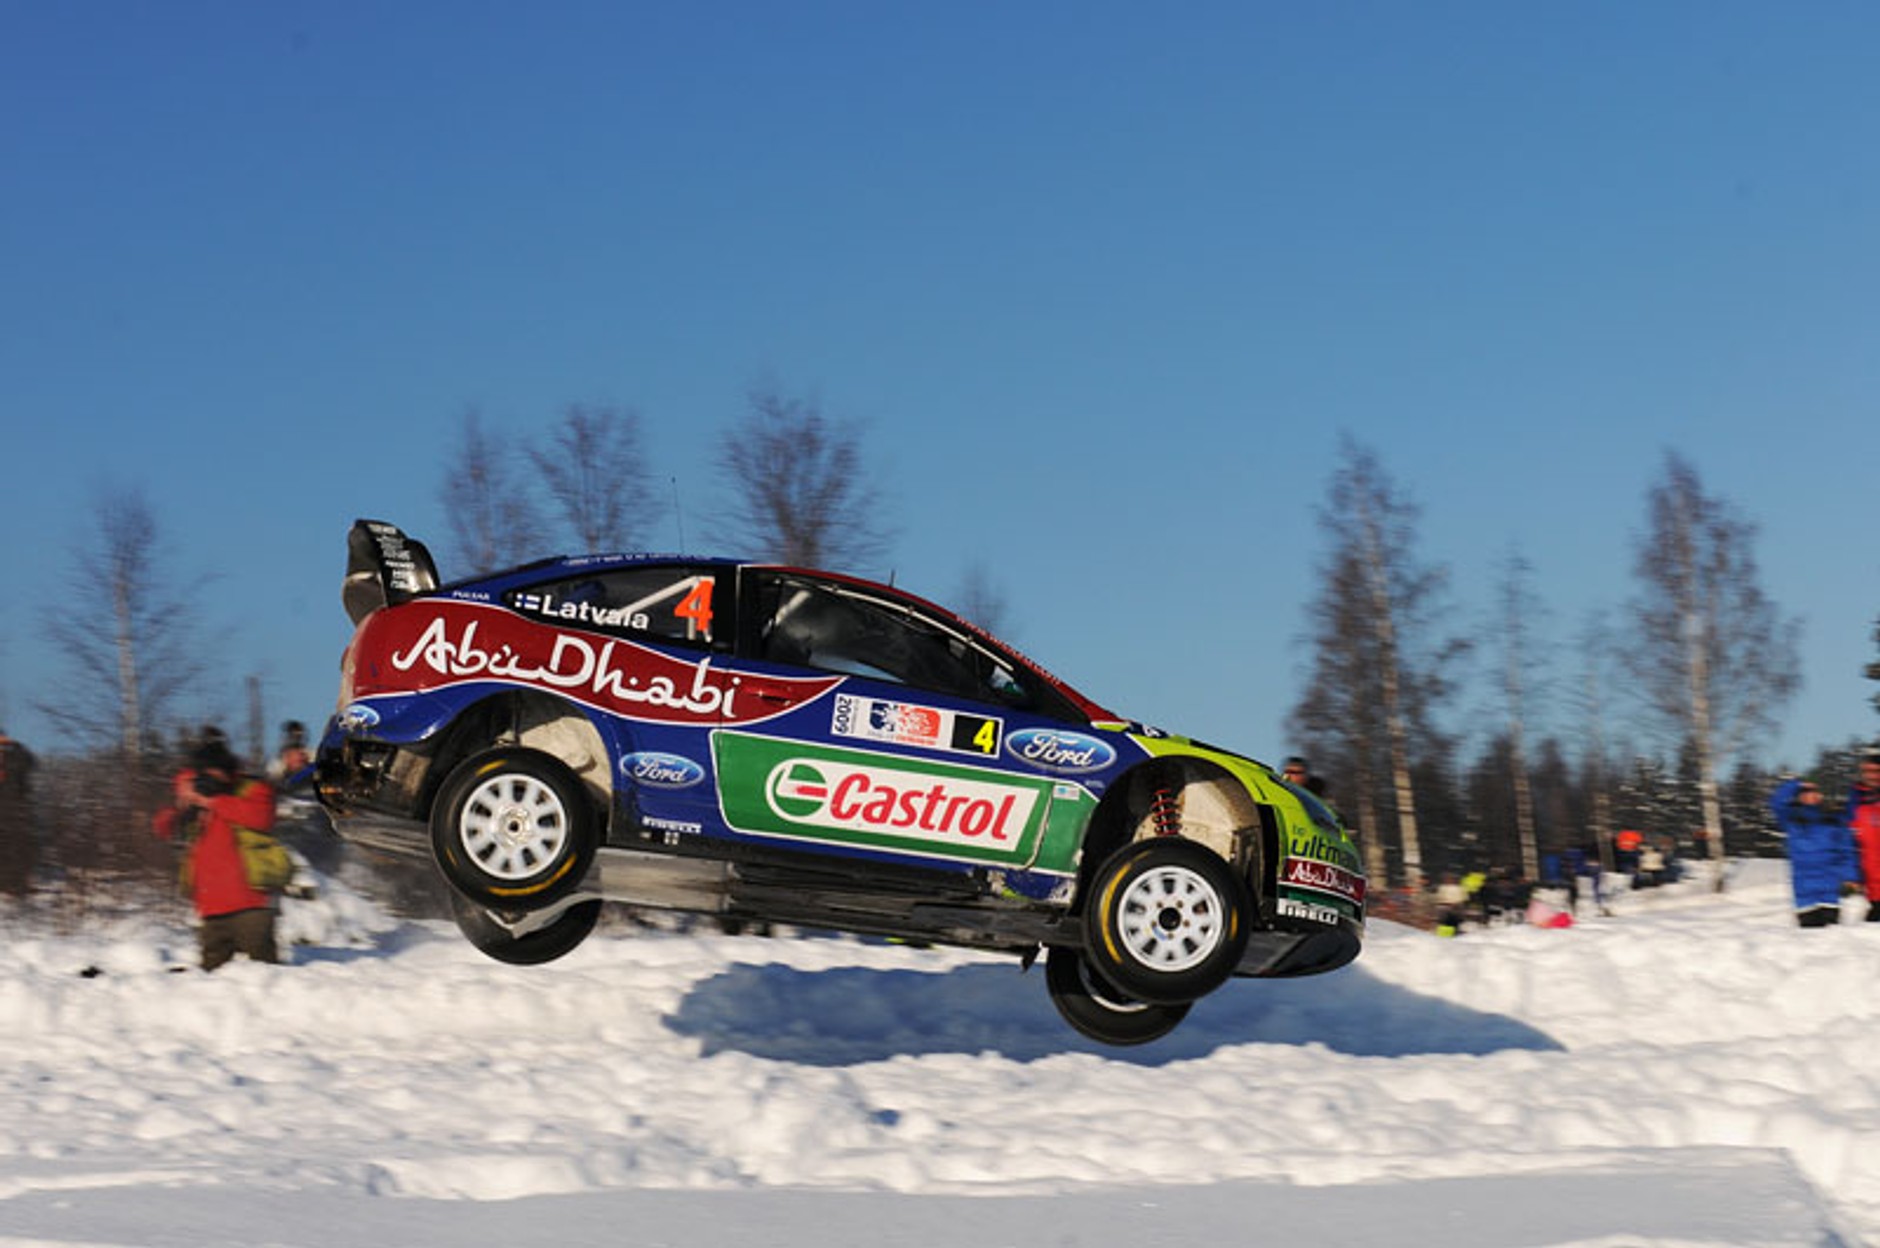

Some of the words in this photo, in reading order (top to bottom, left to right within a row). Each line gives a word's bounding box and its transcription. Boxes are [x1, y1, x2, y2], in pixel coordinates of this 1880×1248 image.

[674, 580, 714, 631] 4
[391, 617, 541, 677] Abu
[540, 634, 741, 718] Dhabi
[834, 696, 851, 734] 2009
[973, 720, 995, 753] 4
[1023, 732, 1096, 766] Ford
[633, 757, 688, 781] Ford
[830, 773, 1016, 840] Castrol
